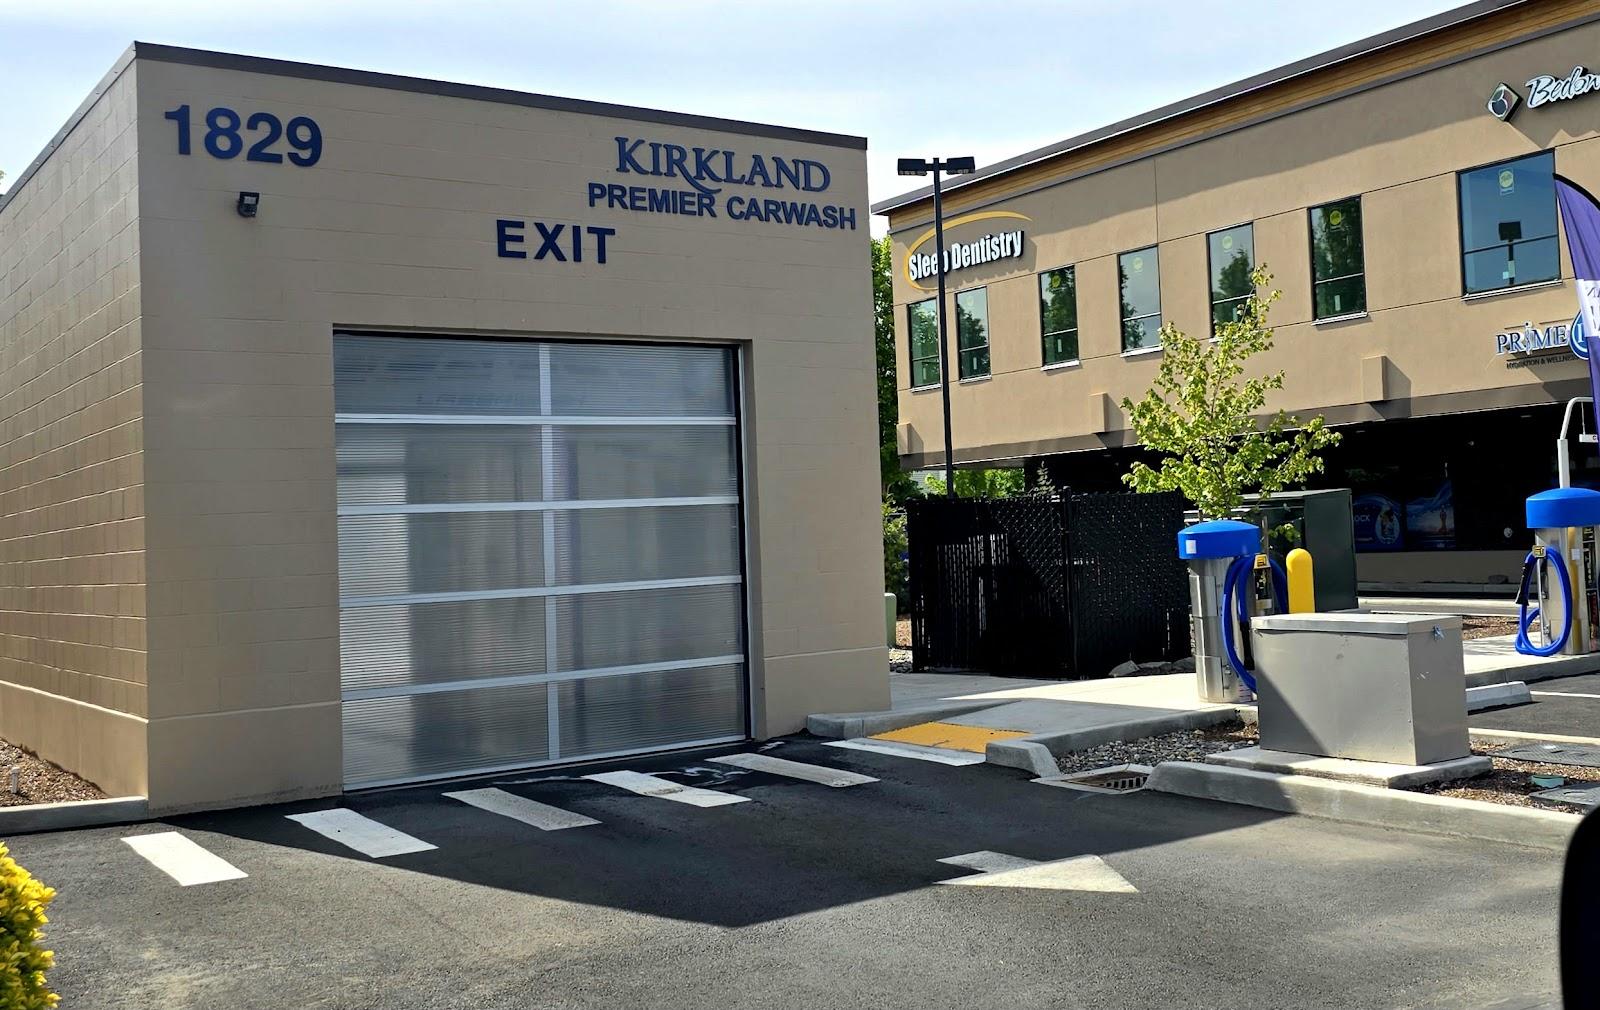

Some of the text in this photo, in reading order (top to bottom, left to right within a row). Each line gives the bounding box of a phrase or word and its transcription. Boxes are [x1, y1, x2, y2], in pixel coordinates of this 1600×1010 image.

[165, 104, 323, 168] 1829
[614, 136, 831, 193] KIRKLAND
[588, 182, 856, 230] PREMIER CARWASH
[496, 219, 616, 264] EXIT
[951, 230, 1022, 270] Dentistry
[1496, 322, 1569, 355] PRIME
[1354, 514, 1371, 522] OCK
